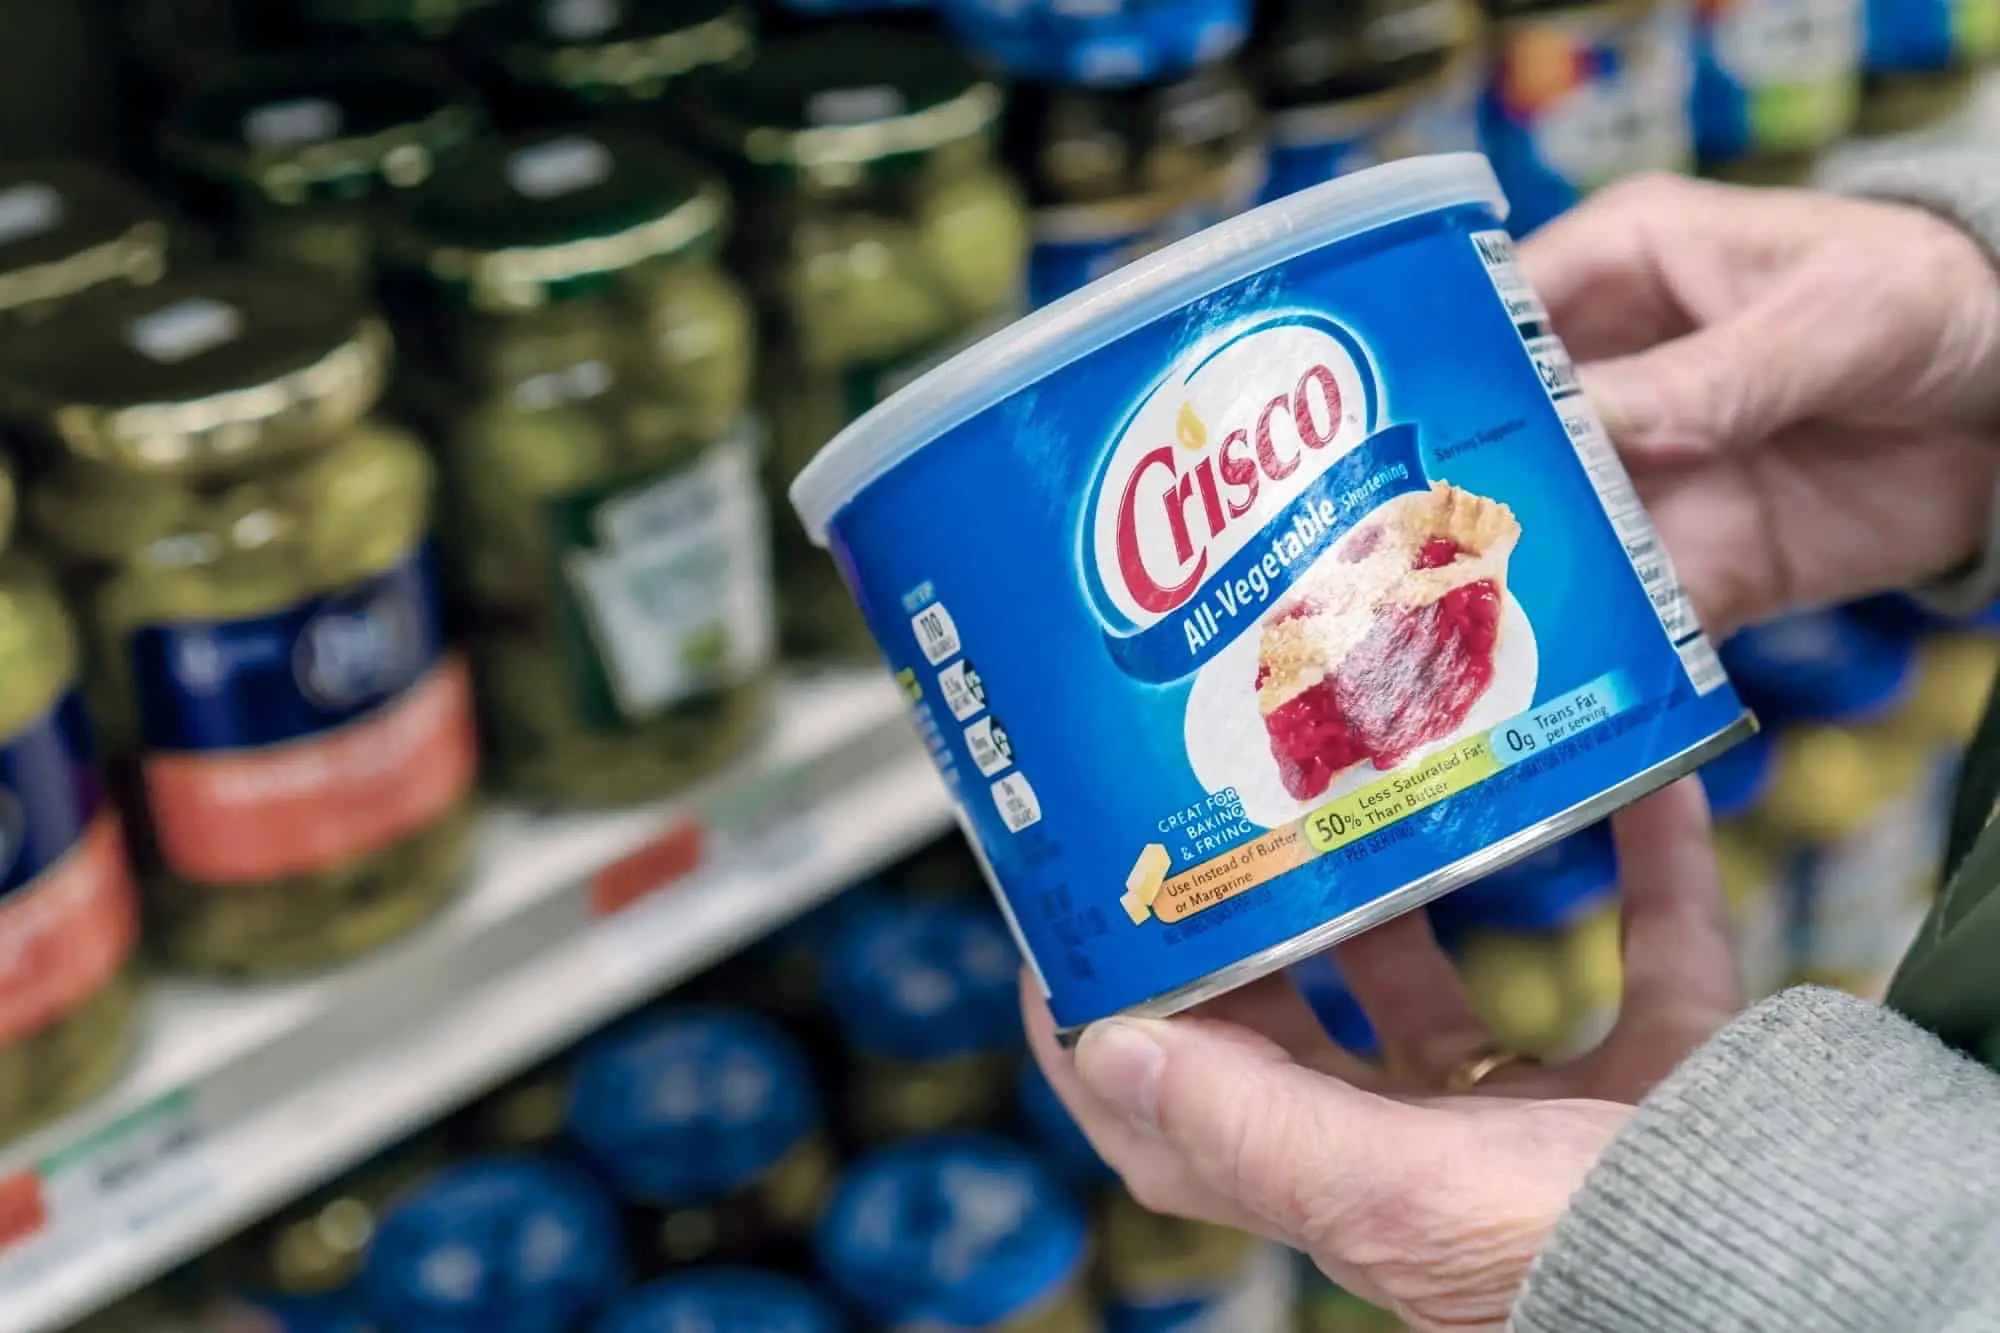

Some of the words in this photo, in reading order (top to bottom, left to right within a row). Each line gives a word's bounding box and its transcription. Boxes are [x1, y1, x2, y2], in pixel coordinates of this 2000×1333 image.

[1116, 364, 1342, 613] Crisco
[1183, 498, 1338, 655] All-Vegetable
[1342, 463, 1409, 511] Shortening
[1533, 706, 1574, 731] Trans
[1575, 692, 1598, 711] Fat
[1546, 726, 1566, 743] per
[1568, 705, 1610, 732] serving
[1505, 729, 1536, 752] 0g
[1358, 788, 1391, 810] Less
[1392, 753, 1461, 793] Saturated
[1462, 743, 1485, 761] Fat
[1158, 804, 1203, 833] GREAT
[1206, 787, 1239, 811] FOR
[1186, 801, 1245, 840] BAKING
[1366, 803, 1403, 825] Than
[1405, 781, 1449, 807] Butter
[1181, 847, 1195, 861] &
[1195, 819, 1251, 854] FRYING
[1315, 812, 1362, 843] 50%
[1166, 880, 1191, 898] Use
[1192, 855, 1240, 887] Instead
[1241, 847, 1255, 865] of
[1256, 832, 1298, 858] Butter
[1175, 899, 1190, 914] or
[1189, 871, 1254, 907] Margarine
